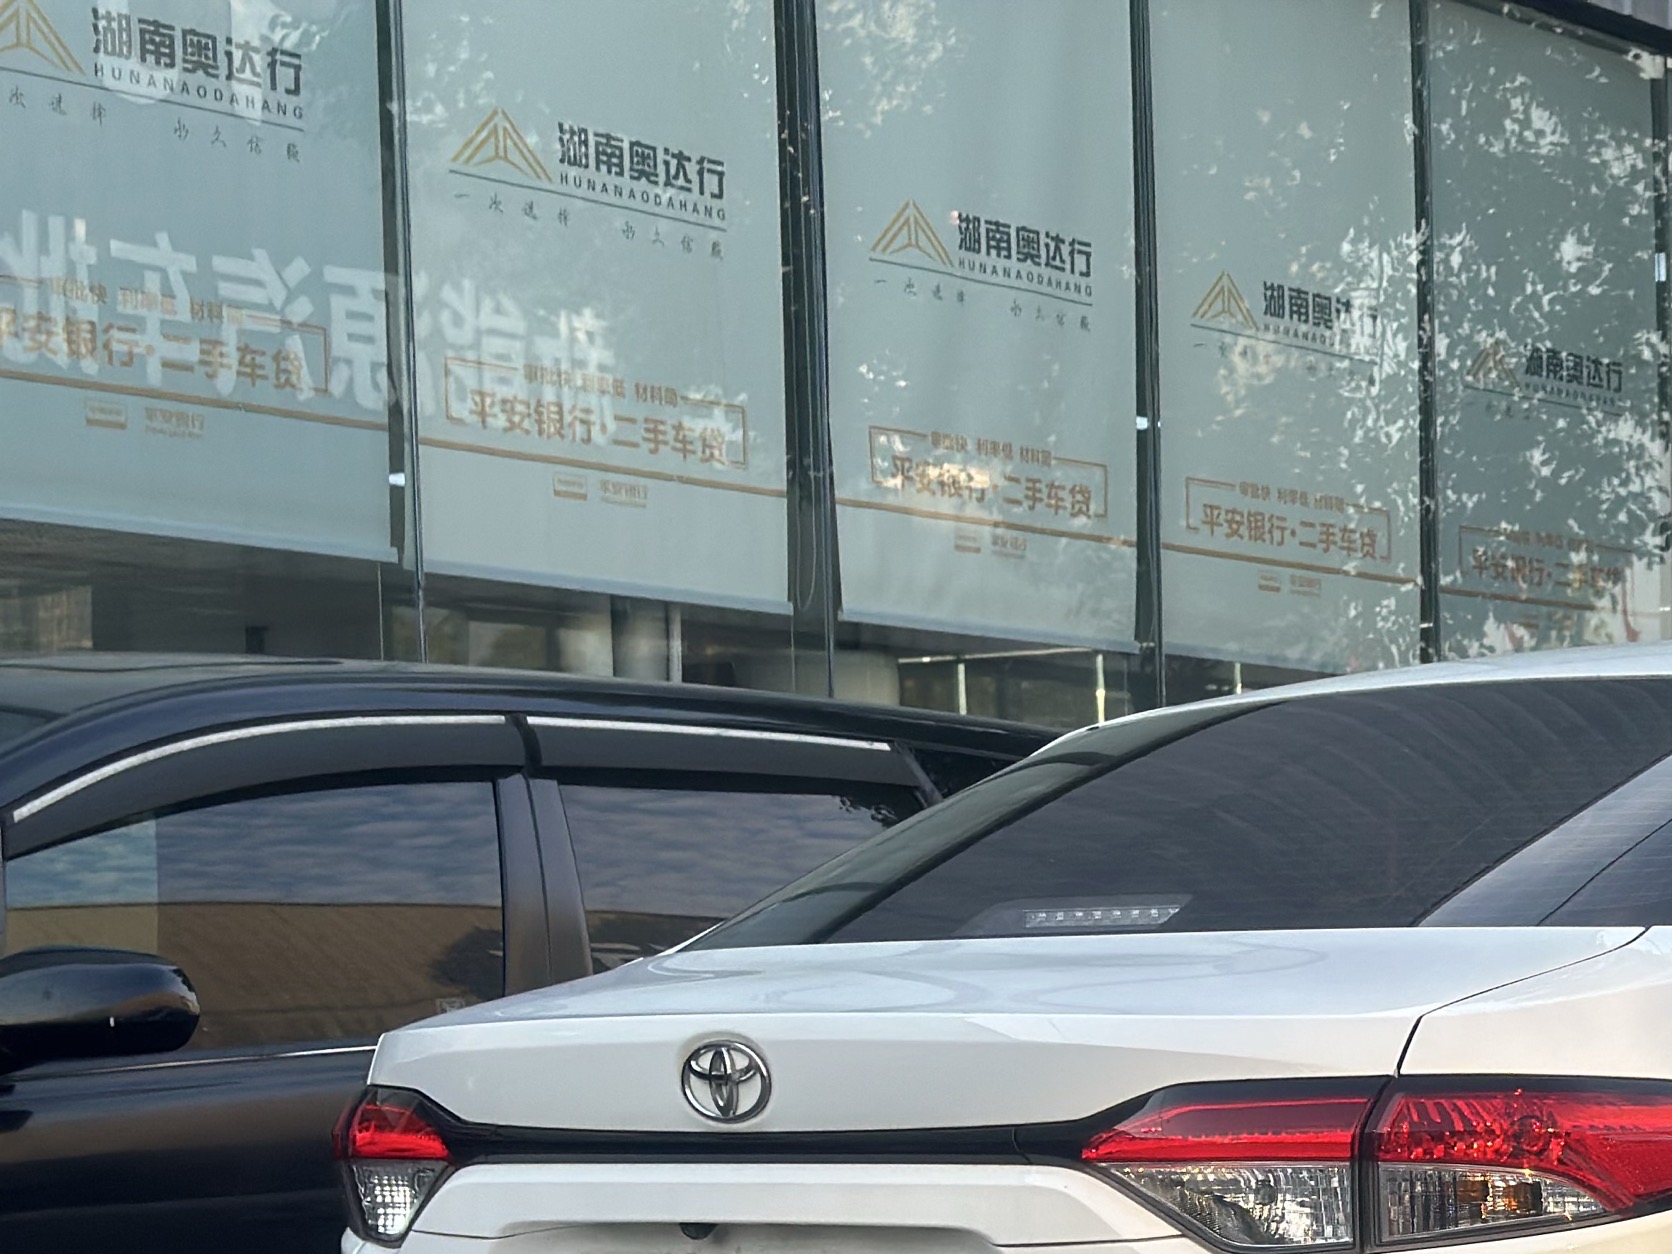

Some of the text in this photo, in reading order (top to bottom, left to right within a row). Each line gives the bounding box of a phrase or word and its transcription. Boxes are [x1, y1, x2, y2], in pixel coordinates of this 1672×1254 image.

[92, 7, 303, 97] 湖南奥达行
[93, 62, 304, 120] HUNANAODAHANG
[557, 121, 727, 200] 湖南奥达行
[559, 171, 728, 222] HUNANAODAHANG
[957, 211, 1093, 278] 湖南奥达行
[957, 257, 1094, 299] HUNANAODAHANG
[1202, 502, 1378, 561] 平安银行·二手车贷
